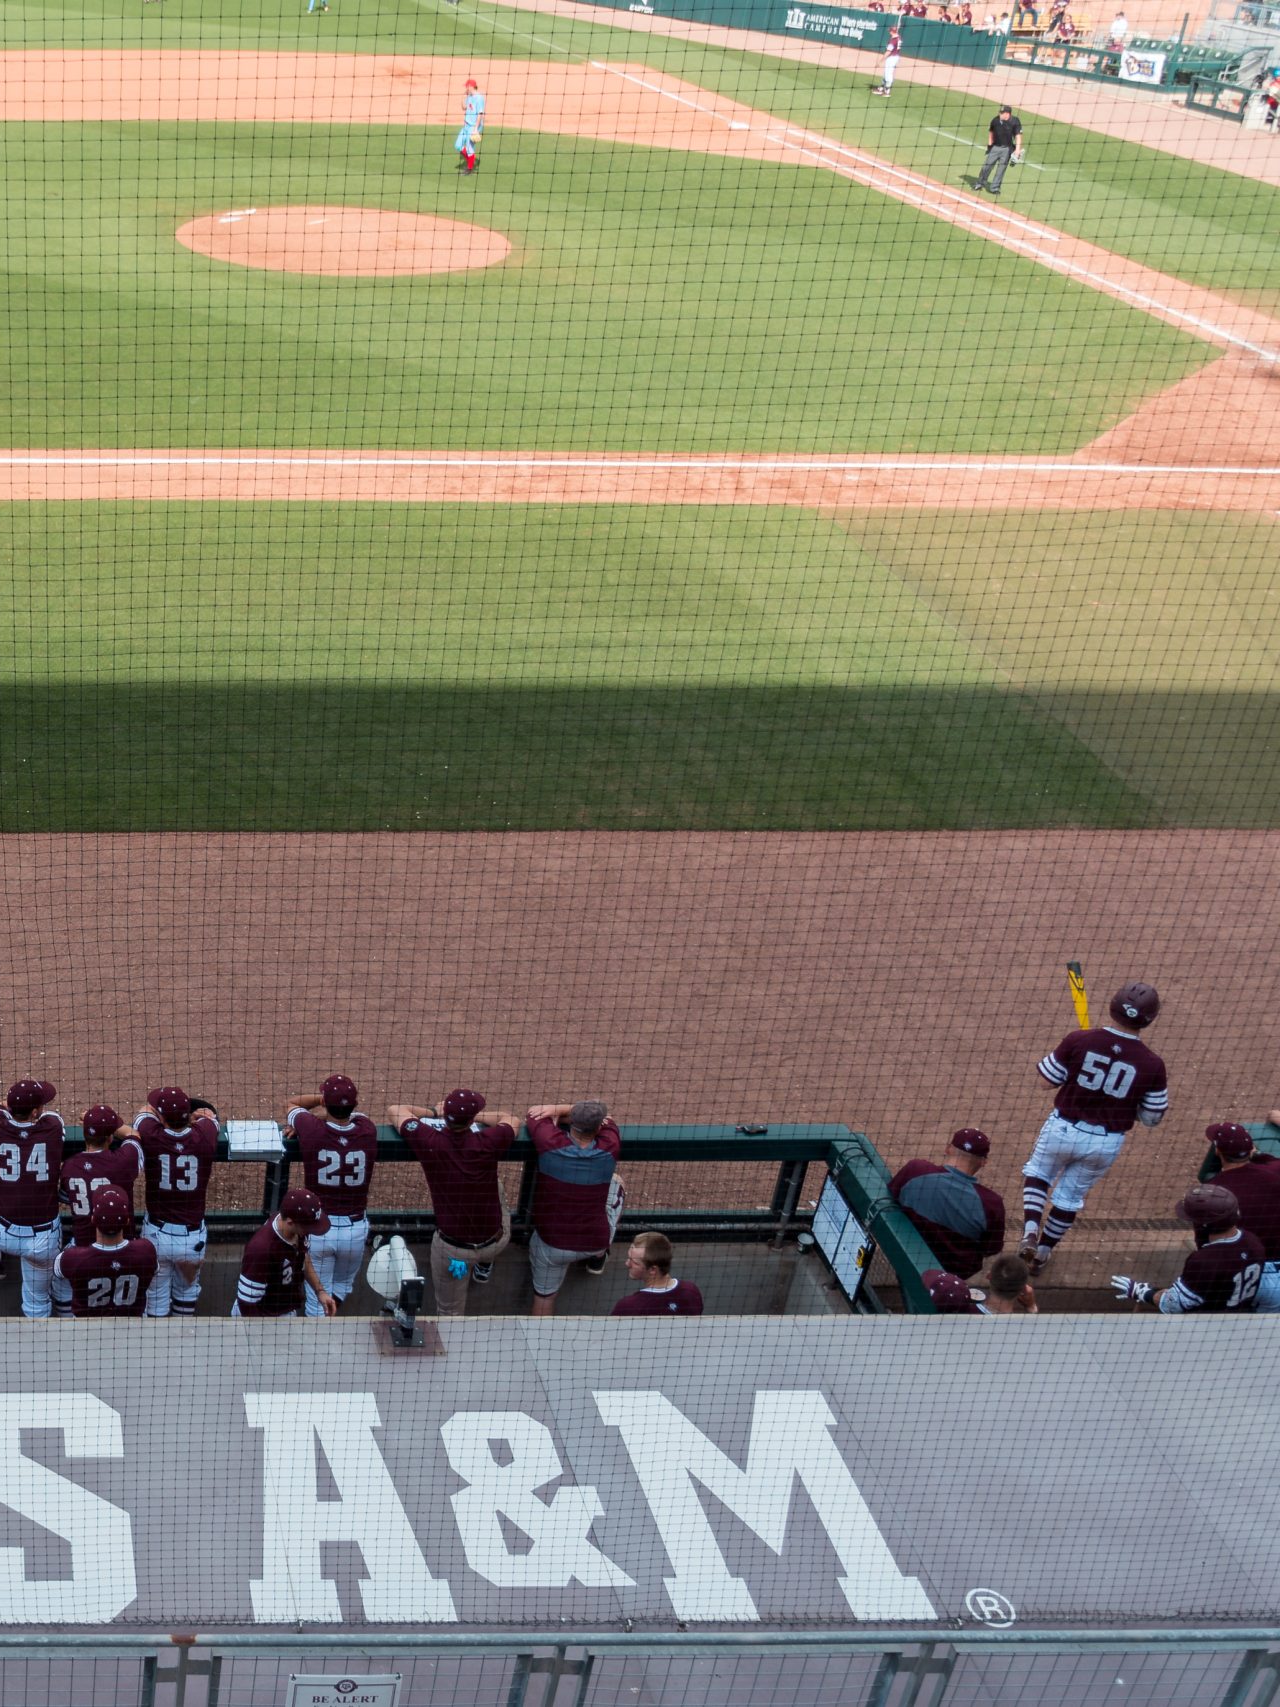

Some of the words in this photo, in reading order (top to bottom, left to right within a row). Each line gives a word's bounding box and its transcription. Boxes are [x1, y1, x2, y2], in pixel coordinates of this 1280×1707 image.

[804, 23, 839, 35] CAMPUS
[805, 14, 840, 26] AMERICAN
[1077, 1051, 1137, 1099] 50
[0, 1142, 50, 1182] 34
[158, 1154, 199, 1192] 13
[318, 1150, 366, 1187] 23
[68, 1177, 112, 1216] 3
[87, 1274, 139, 1307] 20
[1226, 1263, 1261, 1307] 12
[243, 1390, 938, 1623] A&M
[312, 1696, 330, 1704] BE
[332, 1696, 379, 1704] ALERT
